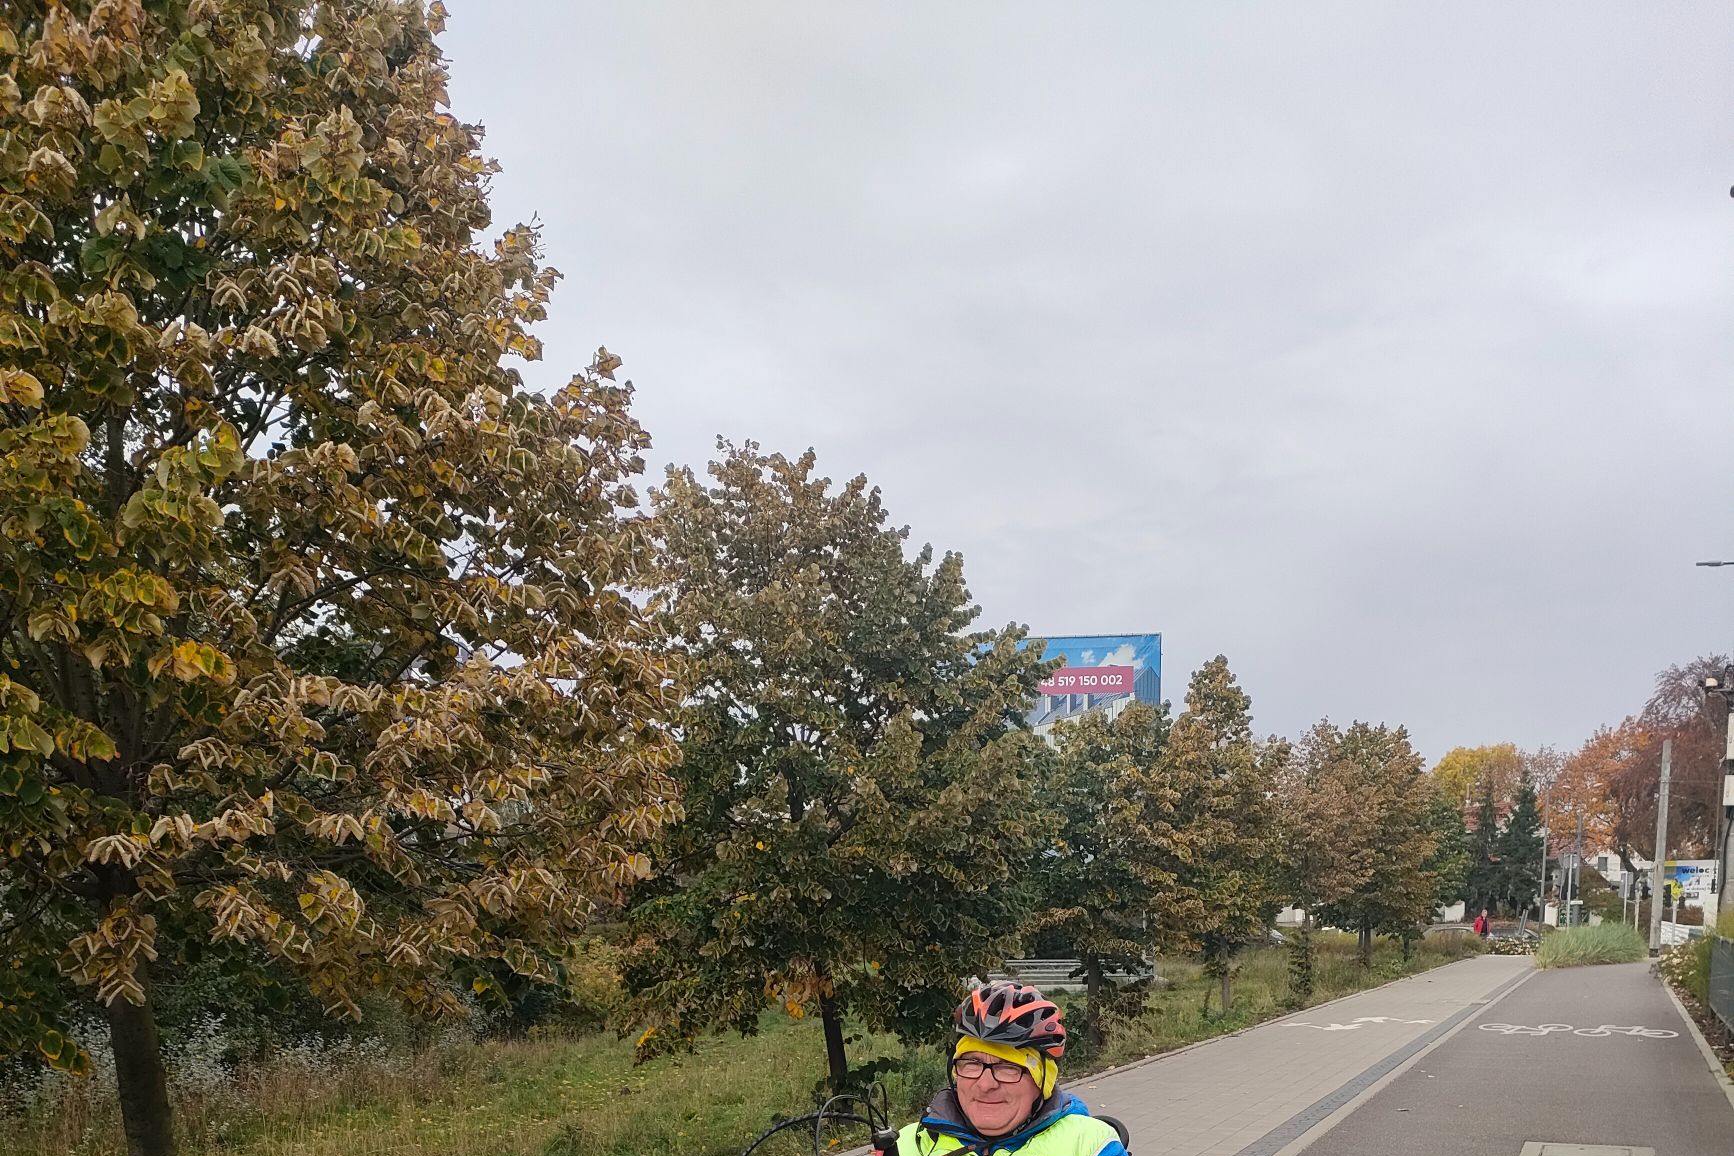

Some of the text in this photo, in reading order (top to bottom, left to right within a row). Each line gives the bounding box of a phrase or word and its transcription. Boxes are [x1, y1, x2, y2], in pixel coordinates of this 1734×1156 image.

[1058, 676, 1076, 686] 519
[1078, 675, 1098, 686] 150
[1100, 675, 1123, 685] 002
